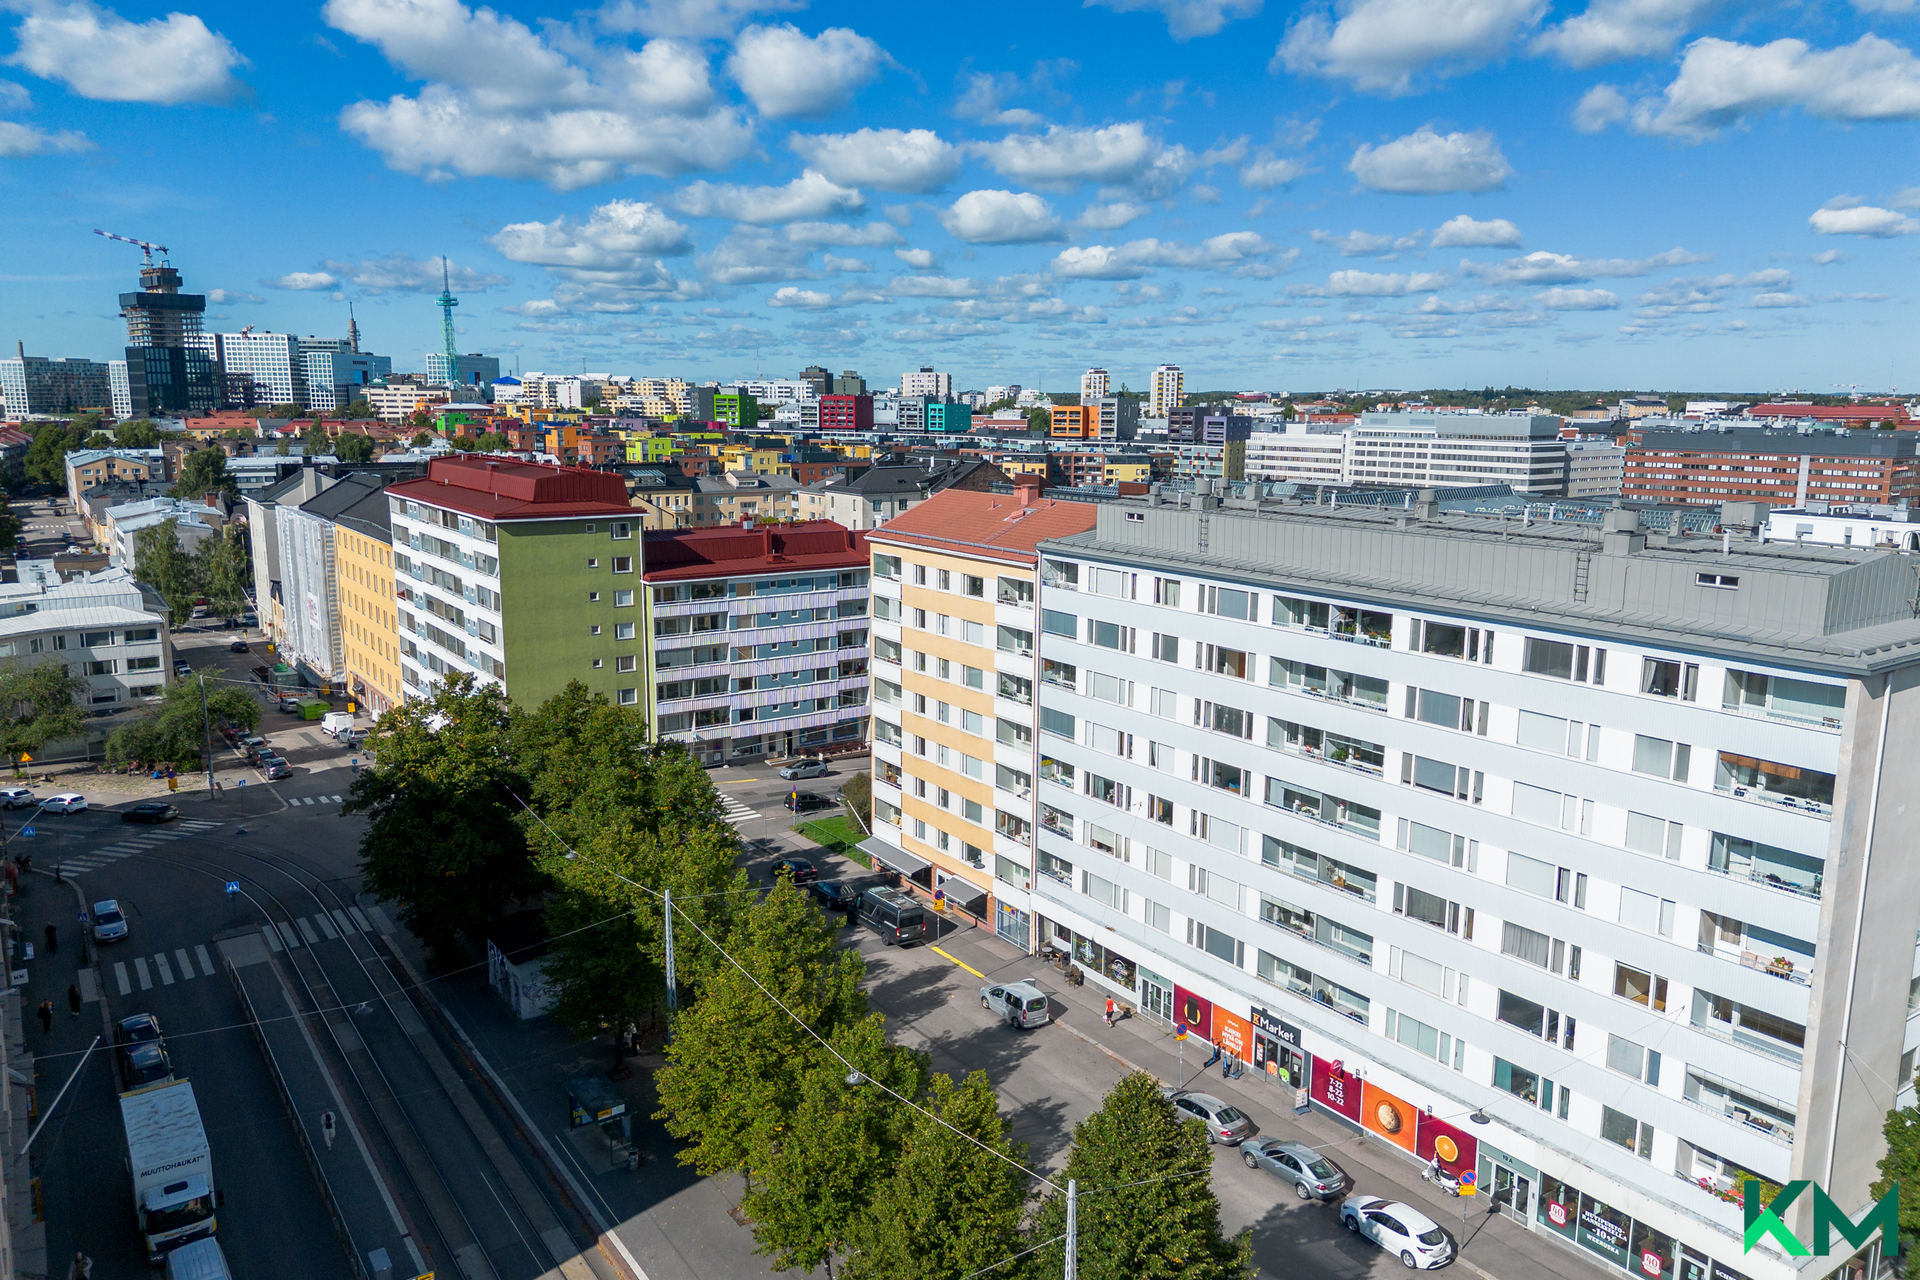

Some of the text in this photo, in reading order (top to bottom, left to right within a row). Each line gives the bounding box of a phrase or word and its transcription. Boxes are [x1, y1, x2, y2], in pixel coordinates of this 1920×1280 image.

[1234, 1037, 1243, 1047] ON
[1329, 1077, 1343, 1090] 7-22
[1327, 1092, 1344, 1107] 10-22
